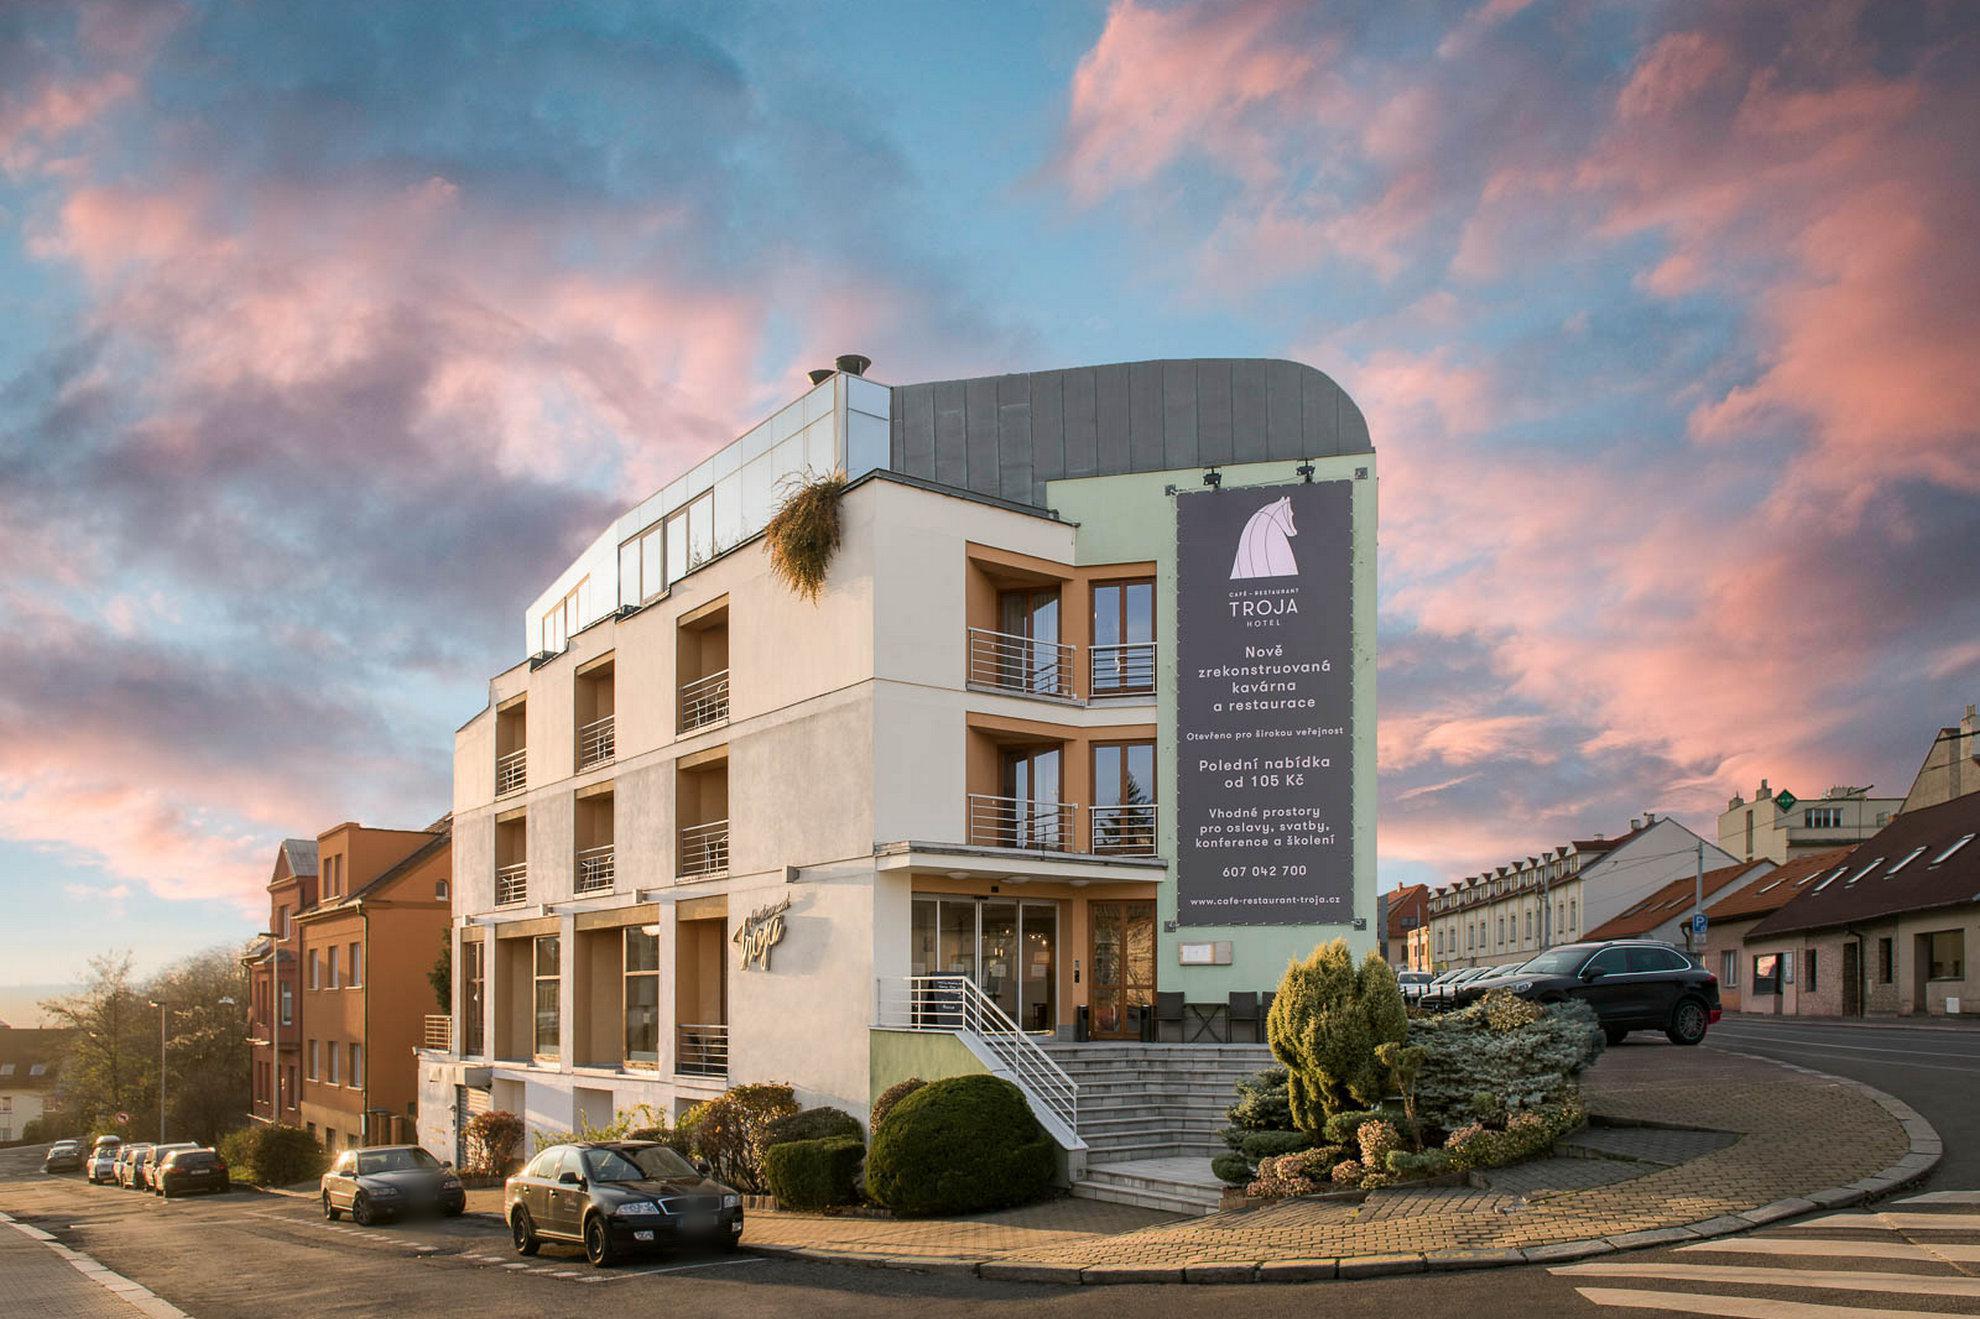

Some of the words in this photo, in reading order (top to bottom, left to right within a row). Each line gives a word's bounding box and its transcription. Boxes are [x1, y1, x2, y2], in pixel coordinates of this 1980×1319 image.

[1229, 598, 1298, 617] TROJA
[1246, 619, 1280, 628] HOTEL
[1245, 644, 1283, 659] Nově
[1198, 659, 1331, 678] zrekonstruovaná
[1232, 680, 1296, 694] kavárna
[1213, 703, 1222, 712] a
[1229, 698, 1316, 711] restaurace
[1186, 731, 1232, 741] Otevřeno
[1235, 732, 1252, 741] pro
[1255, 728, 1293, 738] širokou
[1295, 726, 1344, 738] veřejnost
[1199, 757, 1259, 772] Polední
[1265, 755, 1330, 770] nabídka
[1224, 775, 1244, 789] od
[1251, 774, 1280, 787] 105
[1286, 773, 1304, 786] Kč
[1208, 806, 1258, 819] Vhodné
[1262, 807, 1320, 820] prostory
[1199, 825, 1222, 837] pro
[1226, 822, 1275, 835] oslavy,
[1279, 820, 1330, 833] svatby,
[1195, 833, 1269, 848] konference
[1273, 838, 1282, 846] a
[1286, 833, 1335, 846] školení
[1222, 866, 1247, 878] 607
[1251, 865, 1277, 877] 042
[1282, 865, 1307, 876] 700
[1190, 894, 1340, 906] www.cafe-restaurant-troja.cz
